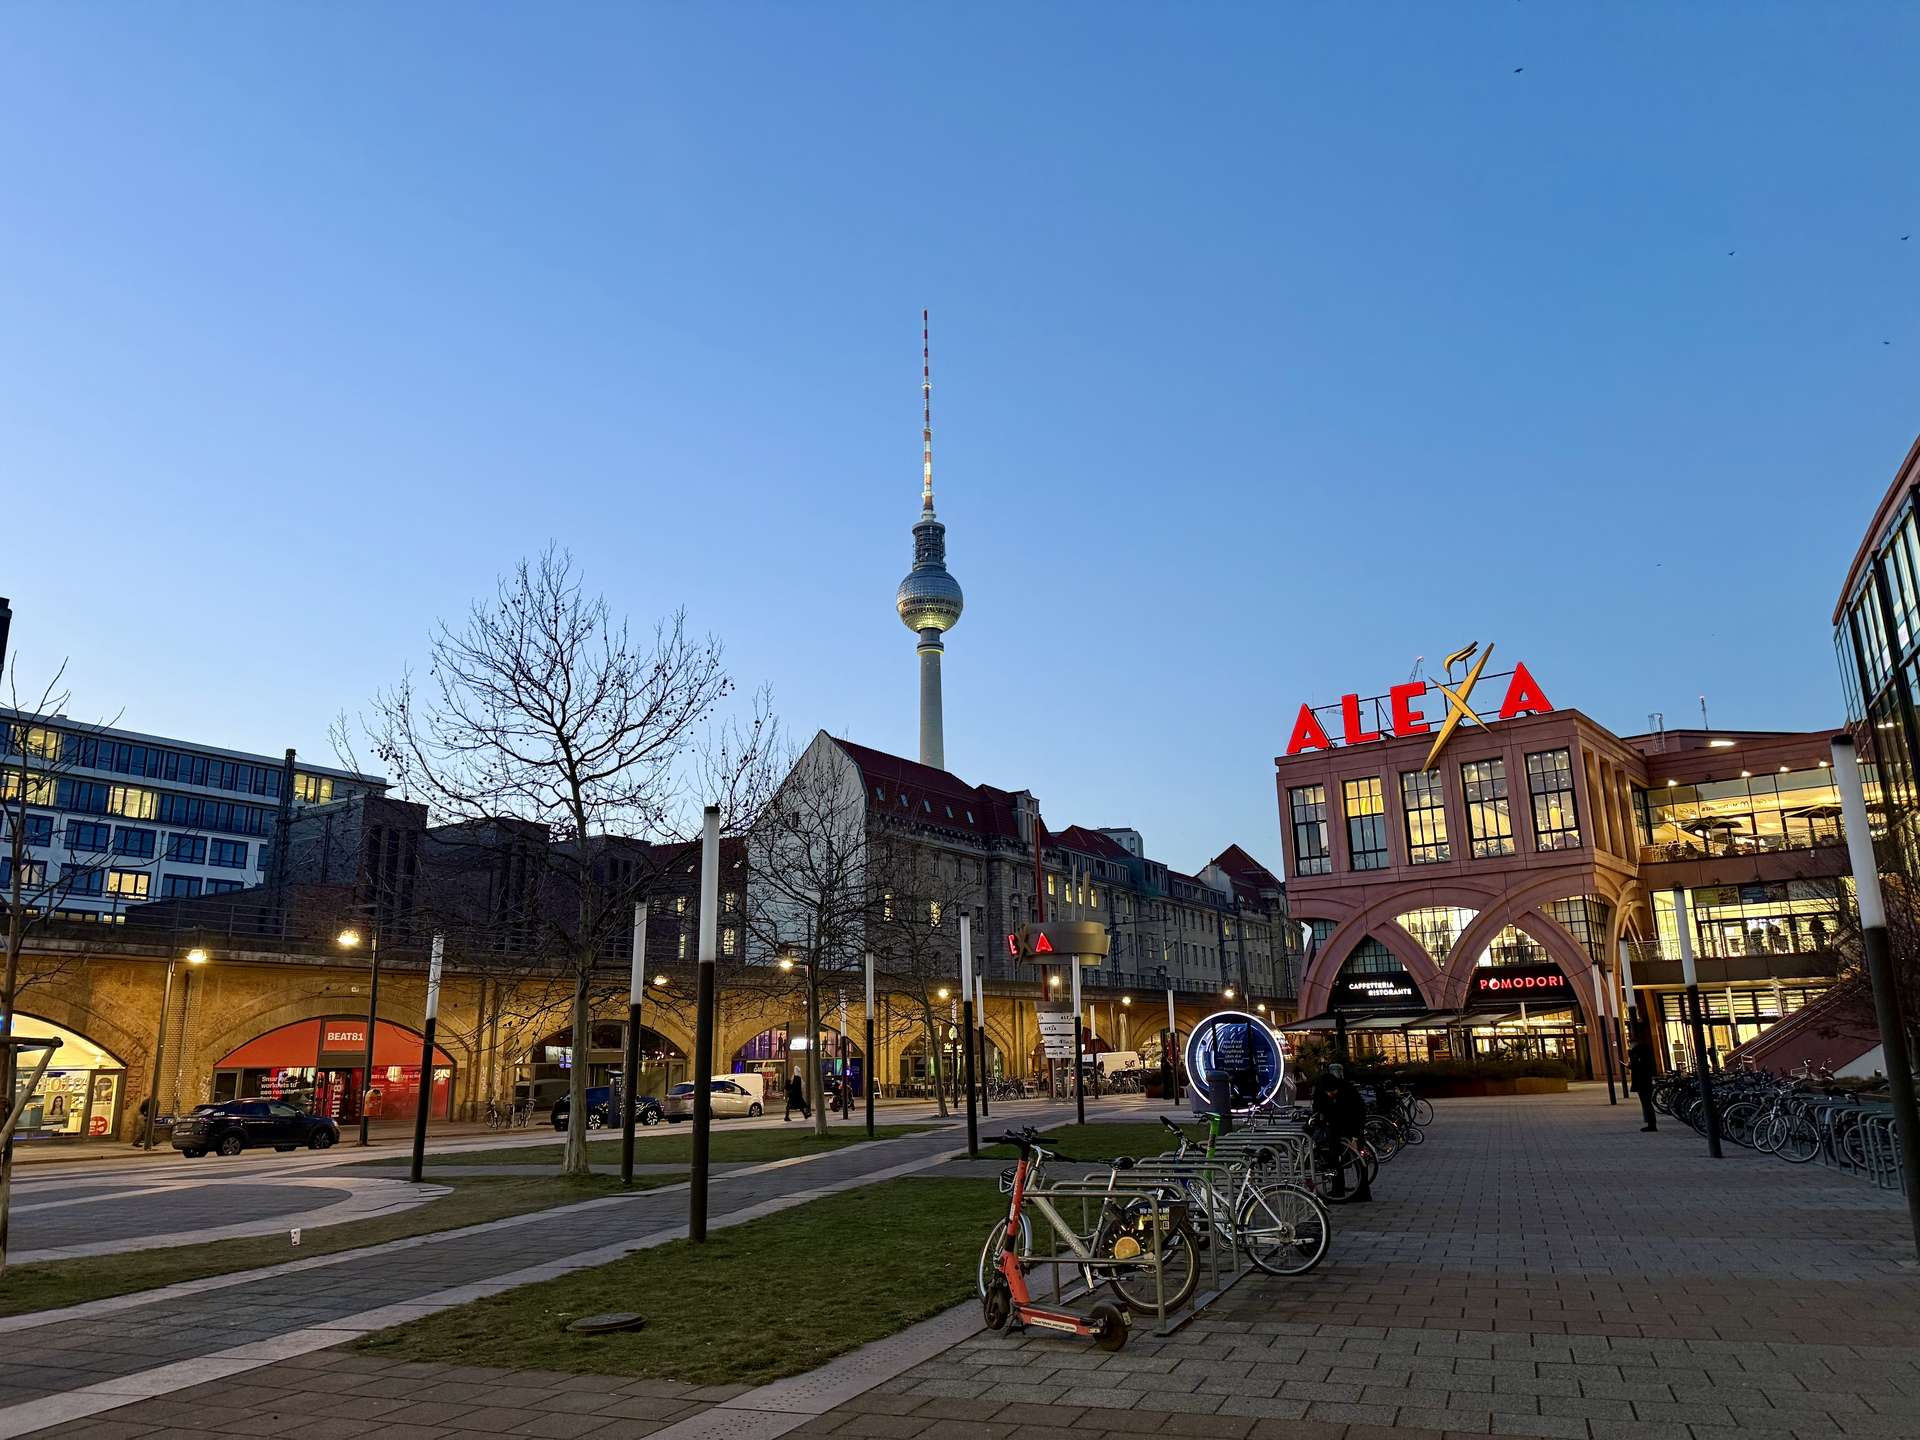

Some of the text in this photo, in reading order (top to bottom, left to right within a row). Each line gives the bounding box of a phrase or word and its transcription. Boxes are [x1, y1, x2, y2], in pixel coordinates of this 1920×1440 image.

[1286, 642, 1554, 774] ALEXA
[1348, 981, 1395, 990] CAFFETTERIA
[1479, 975, 1564, 991] POMODORI
[1367, 988, 1412, 997] RISTORANTE
[327, 1032, 364, 1041] BEAT81
